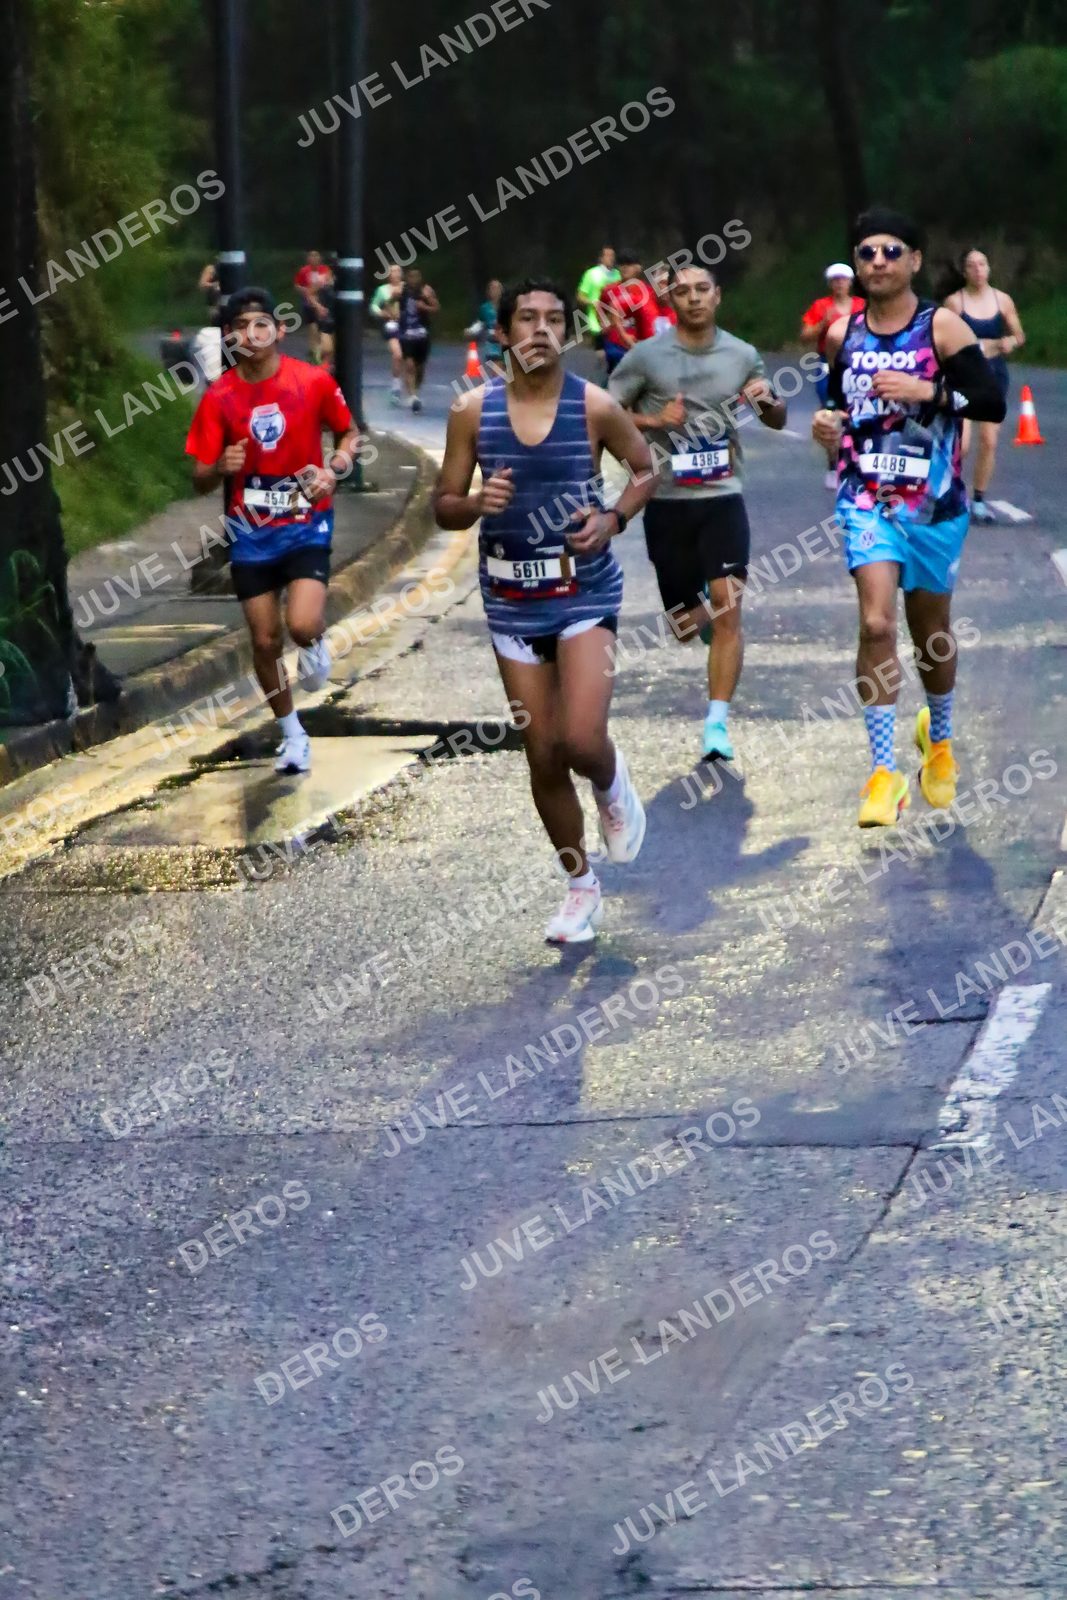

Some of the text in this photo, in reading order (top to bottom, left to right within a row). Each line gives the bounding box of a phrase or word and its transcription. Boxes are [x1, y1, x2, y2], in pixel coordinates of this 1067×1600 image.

[851, 350, 917, 369] TODOS
[692, 451, 720, 467] 4385
[872, 455, 907, 473] 4489
[512, 560, 547, 579] 5611
